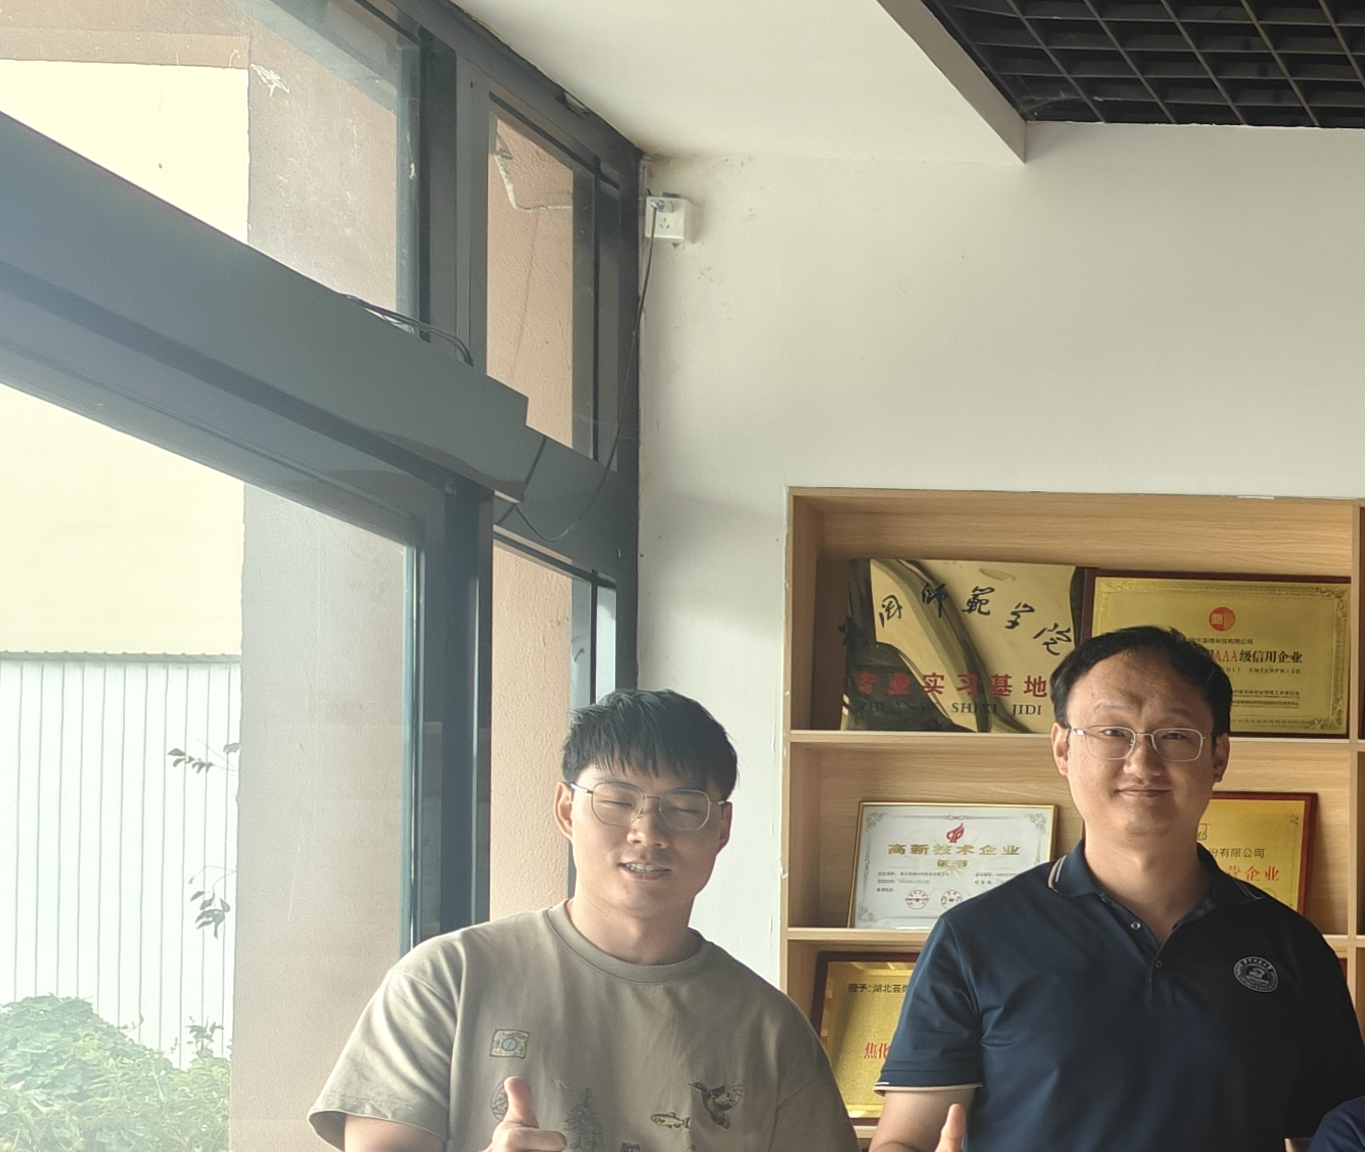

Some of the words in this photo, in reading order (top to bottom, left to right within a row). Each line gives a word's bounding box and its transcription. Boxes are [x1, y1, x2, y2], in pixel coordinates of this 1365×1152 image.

[1209, 649, 1303, 663] AAA级信用企业
[854, 670, 1048, 698] 专业实习基地
[1011, 703, 1043, 716] JIDI
[887, 843, 1021, 856] 高新技术企业
